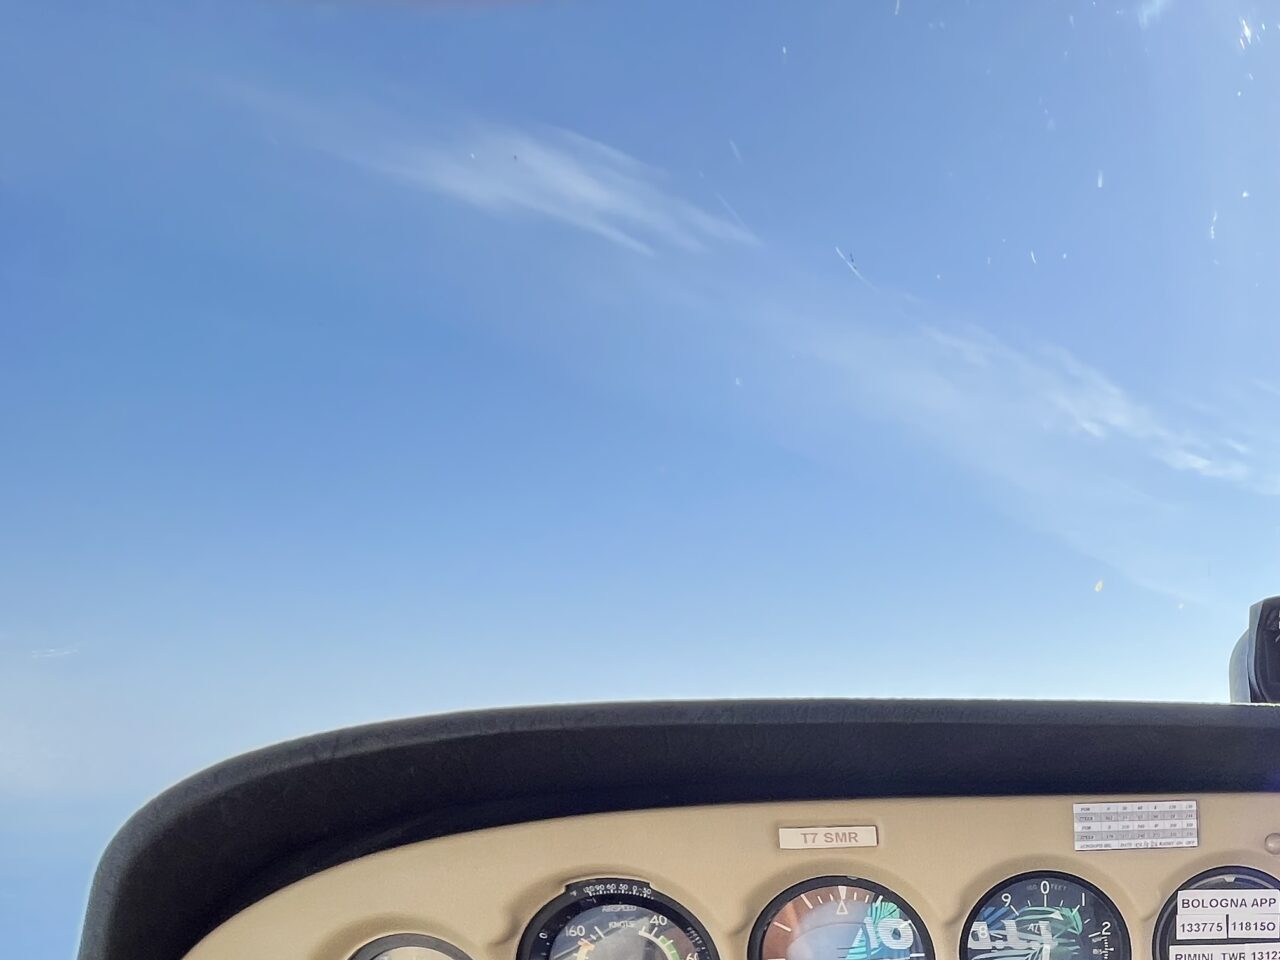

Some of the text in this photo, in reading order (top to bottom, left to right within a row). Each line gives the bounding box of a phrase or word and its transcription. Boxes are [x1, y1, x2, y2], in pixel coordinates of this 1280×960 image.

[801, 832, 859, 844] T7 SMR
[1040, 880, 1050, 894] 0
[1181, 898, 1277, 909] BOLOGNA APP
[649, 915, 668, 926] 40
[565, 926, 586, 936] 160
[1179, 922, 1223, 933] 133775
